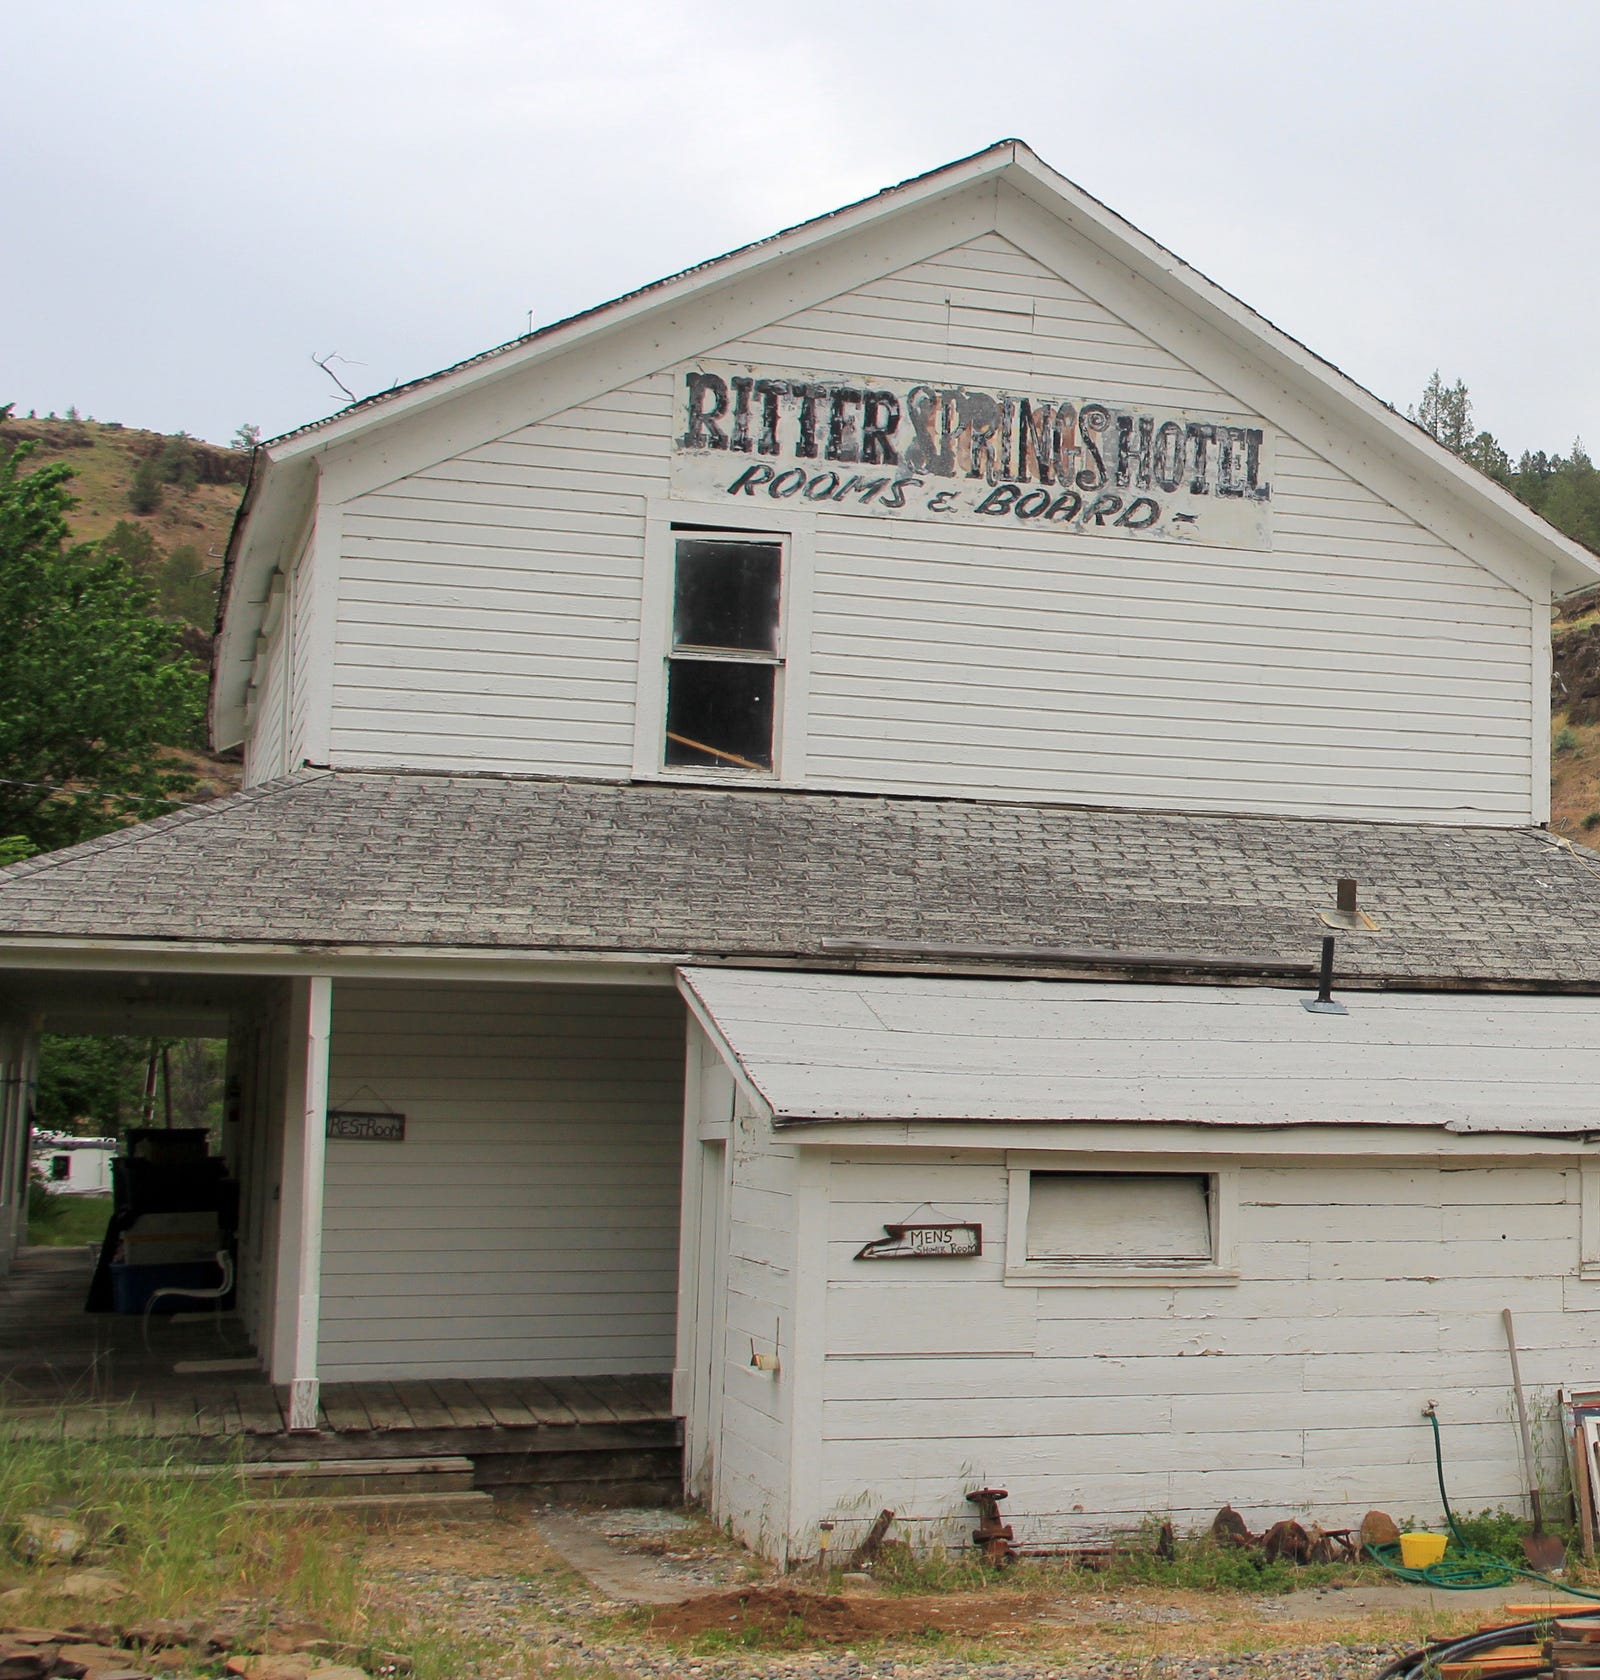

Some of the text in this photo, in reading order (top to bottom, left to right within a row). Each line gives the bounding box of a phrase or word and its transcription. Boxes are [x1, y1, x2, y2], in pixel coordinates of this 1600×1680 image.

[682, 372, 1273, 502] RITTER SPRINGS HOTEL
[727, 465, 1162, 529] ROOMS & BOARD
[910, 1230, 953, 1246] MENS
[950, 1242, 978, 1254] ROOM
